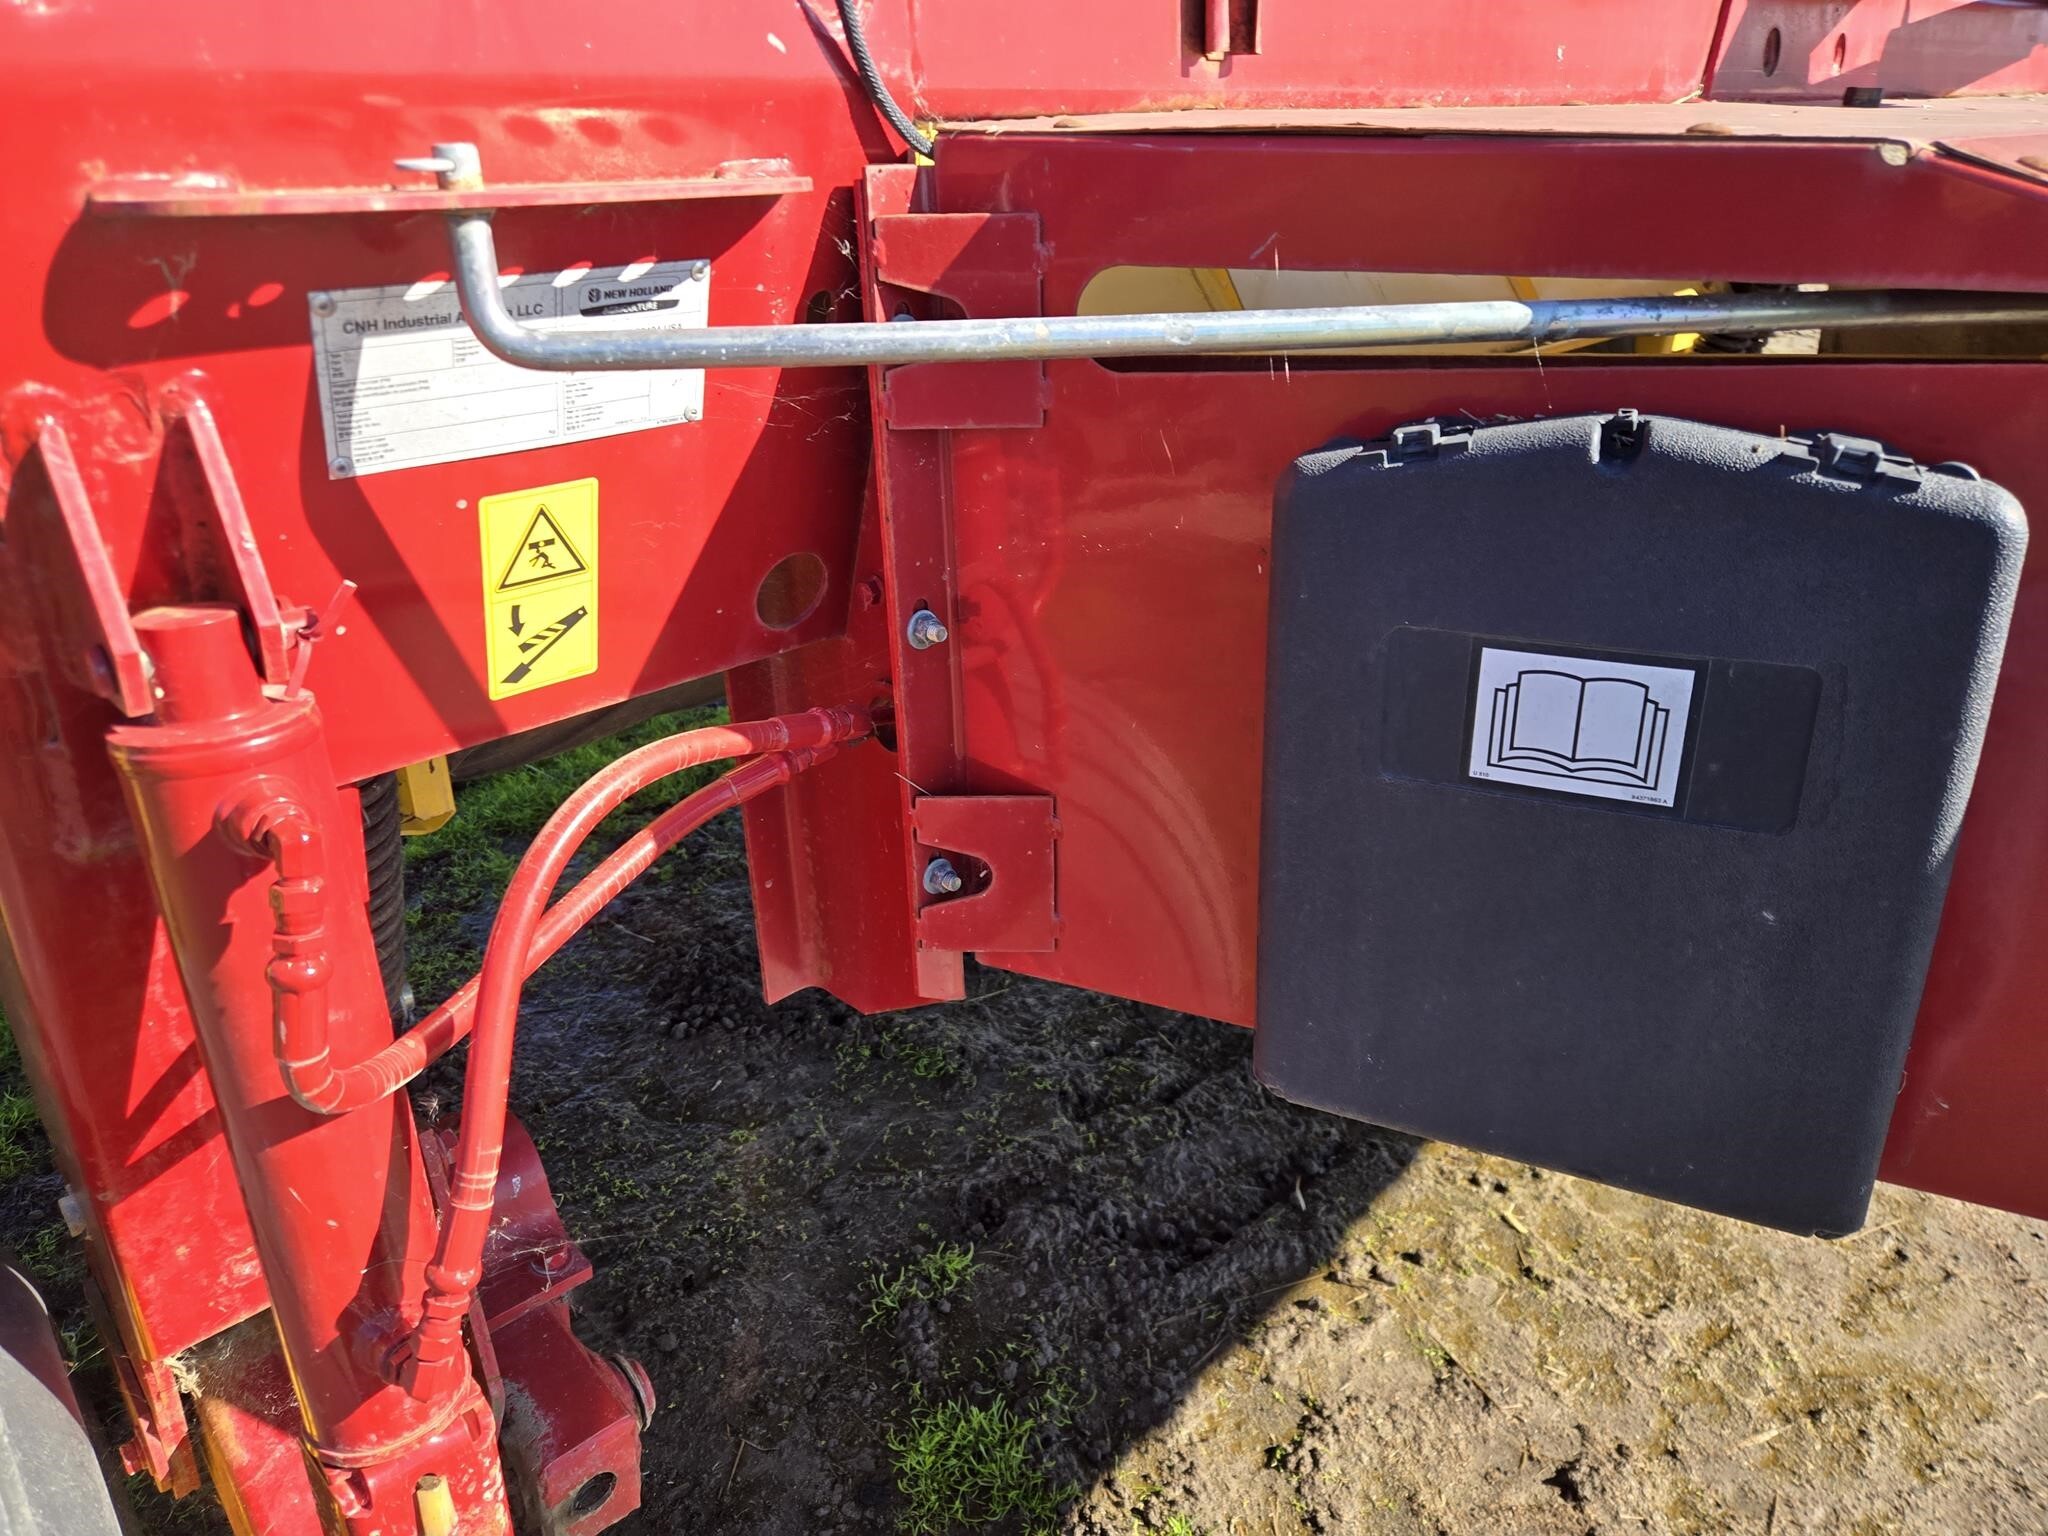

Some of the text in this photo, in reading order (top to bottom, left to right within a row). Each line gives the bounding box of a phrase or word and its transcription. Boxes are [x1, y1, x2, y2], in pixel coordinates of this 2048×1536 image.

[604, 285, 674, 299] NEW HOLLAND
[342, 318, 378, 335] CNH
[383, 313, 453, 330] Industrial
[516, 303, 544, 318] LLC
